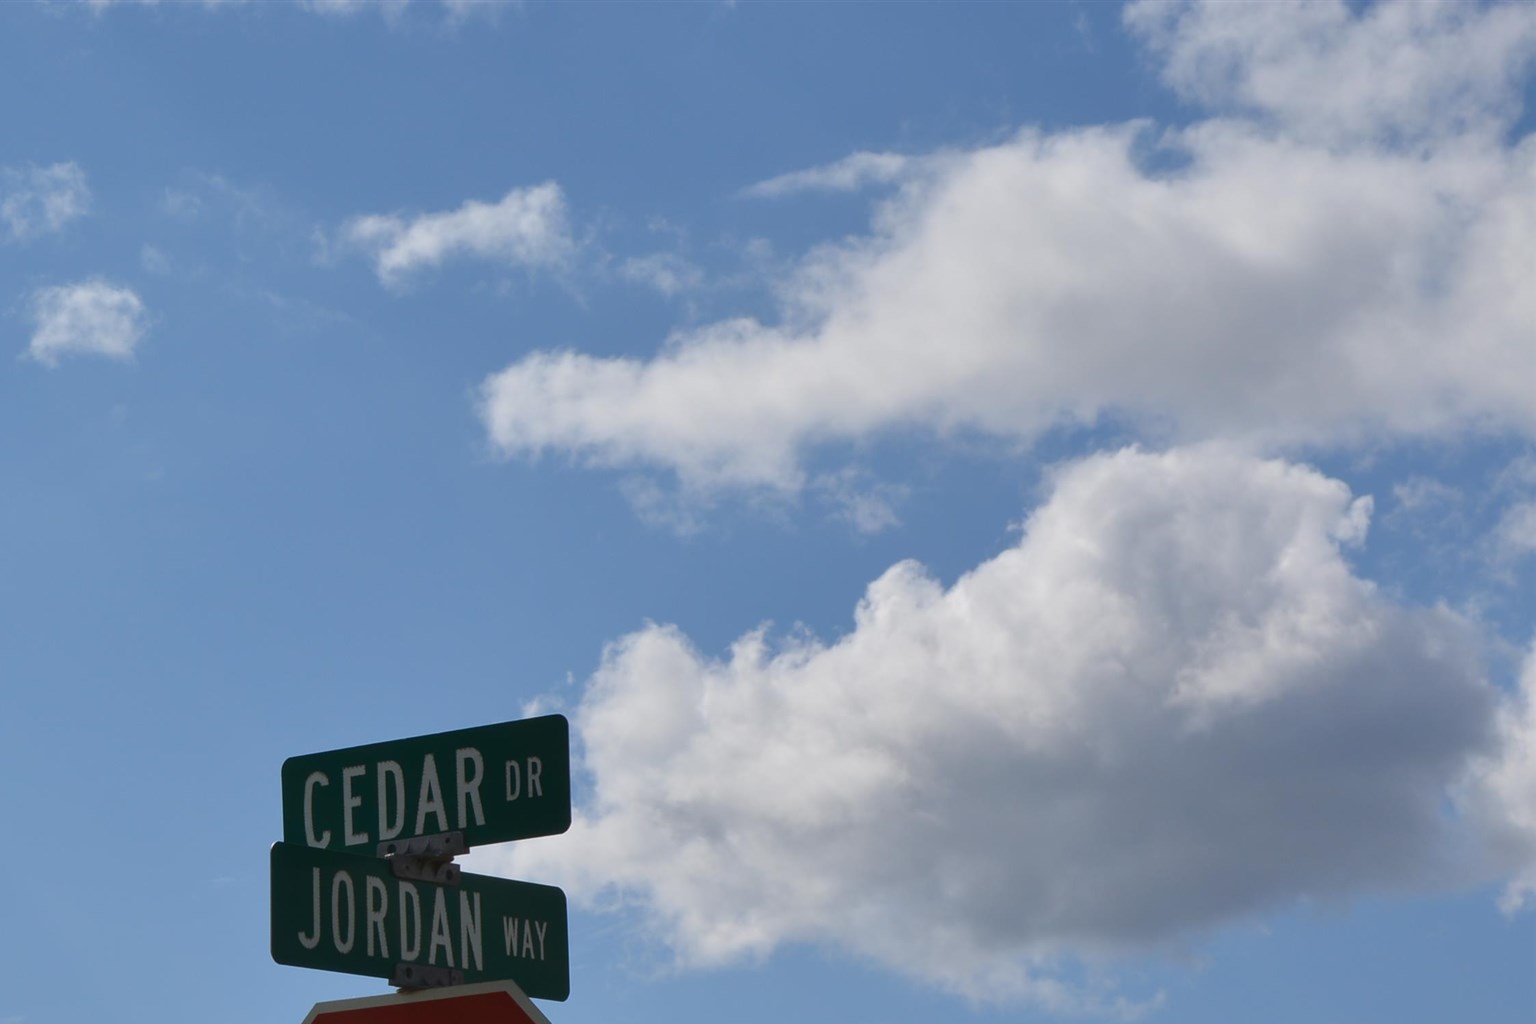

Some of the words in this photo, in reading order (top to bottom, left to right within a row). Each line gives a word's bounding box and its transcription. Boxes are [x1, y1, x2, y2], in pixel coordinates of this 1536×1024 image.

[304, 747, 485, 849] CEDAR
[505, 756, 542, 801] DR
[298, 867, 483, 971] JORDAN
[503, 916, 547, 961] WAY
